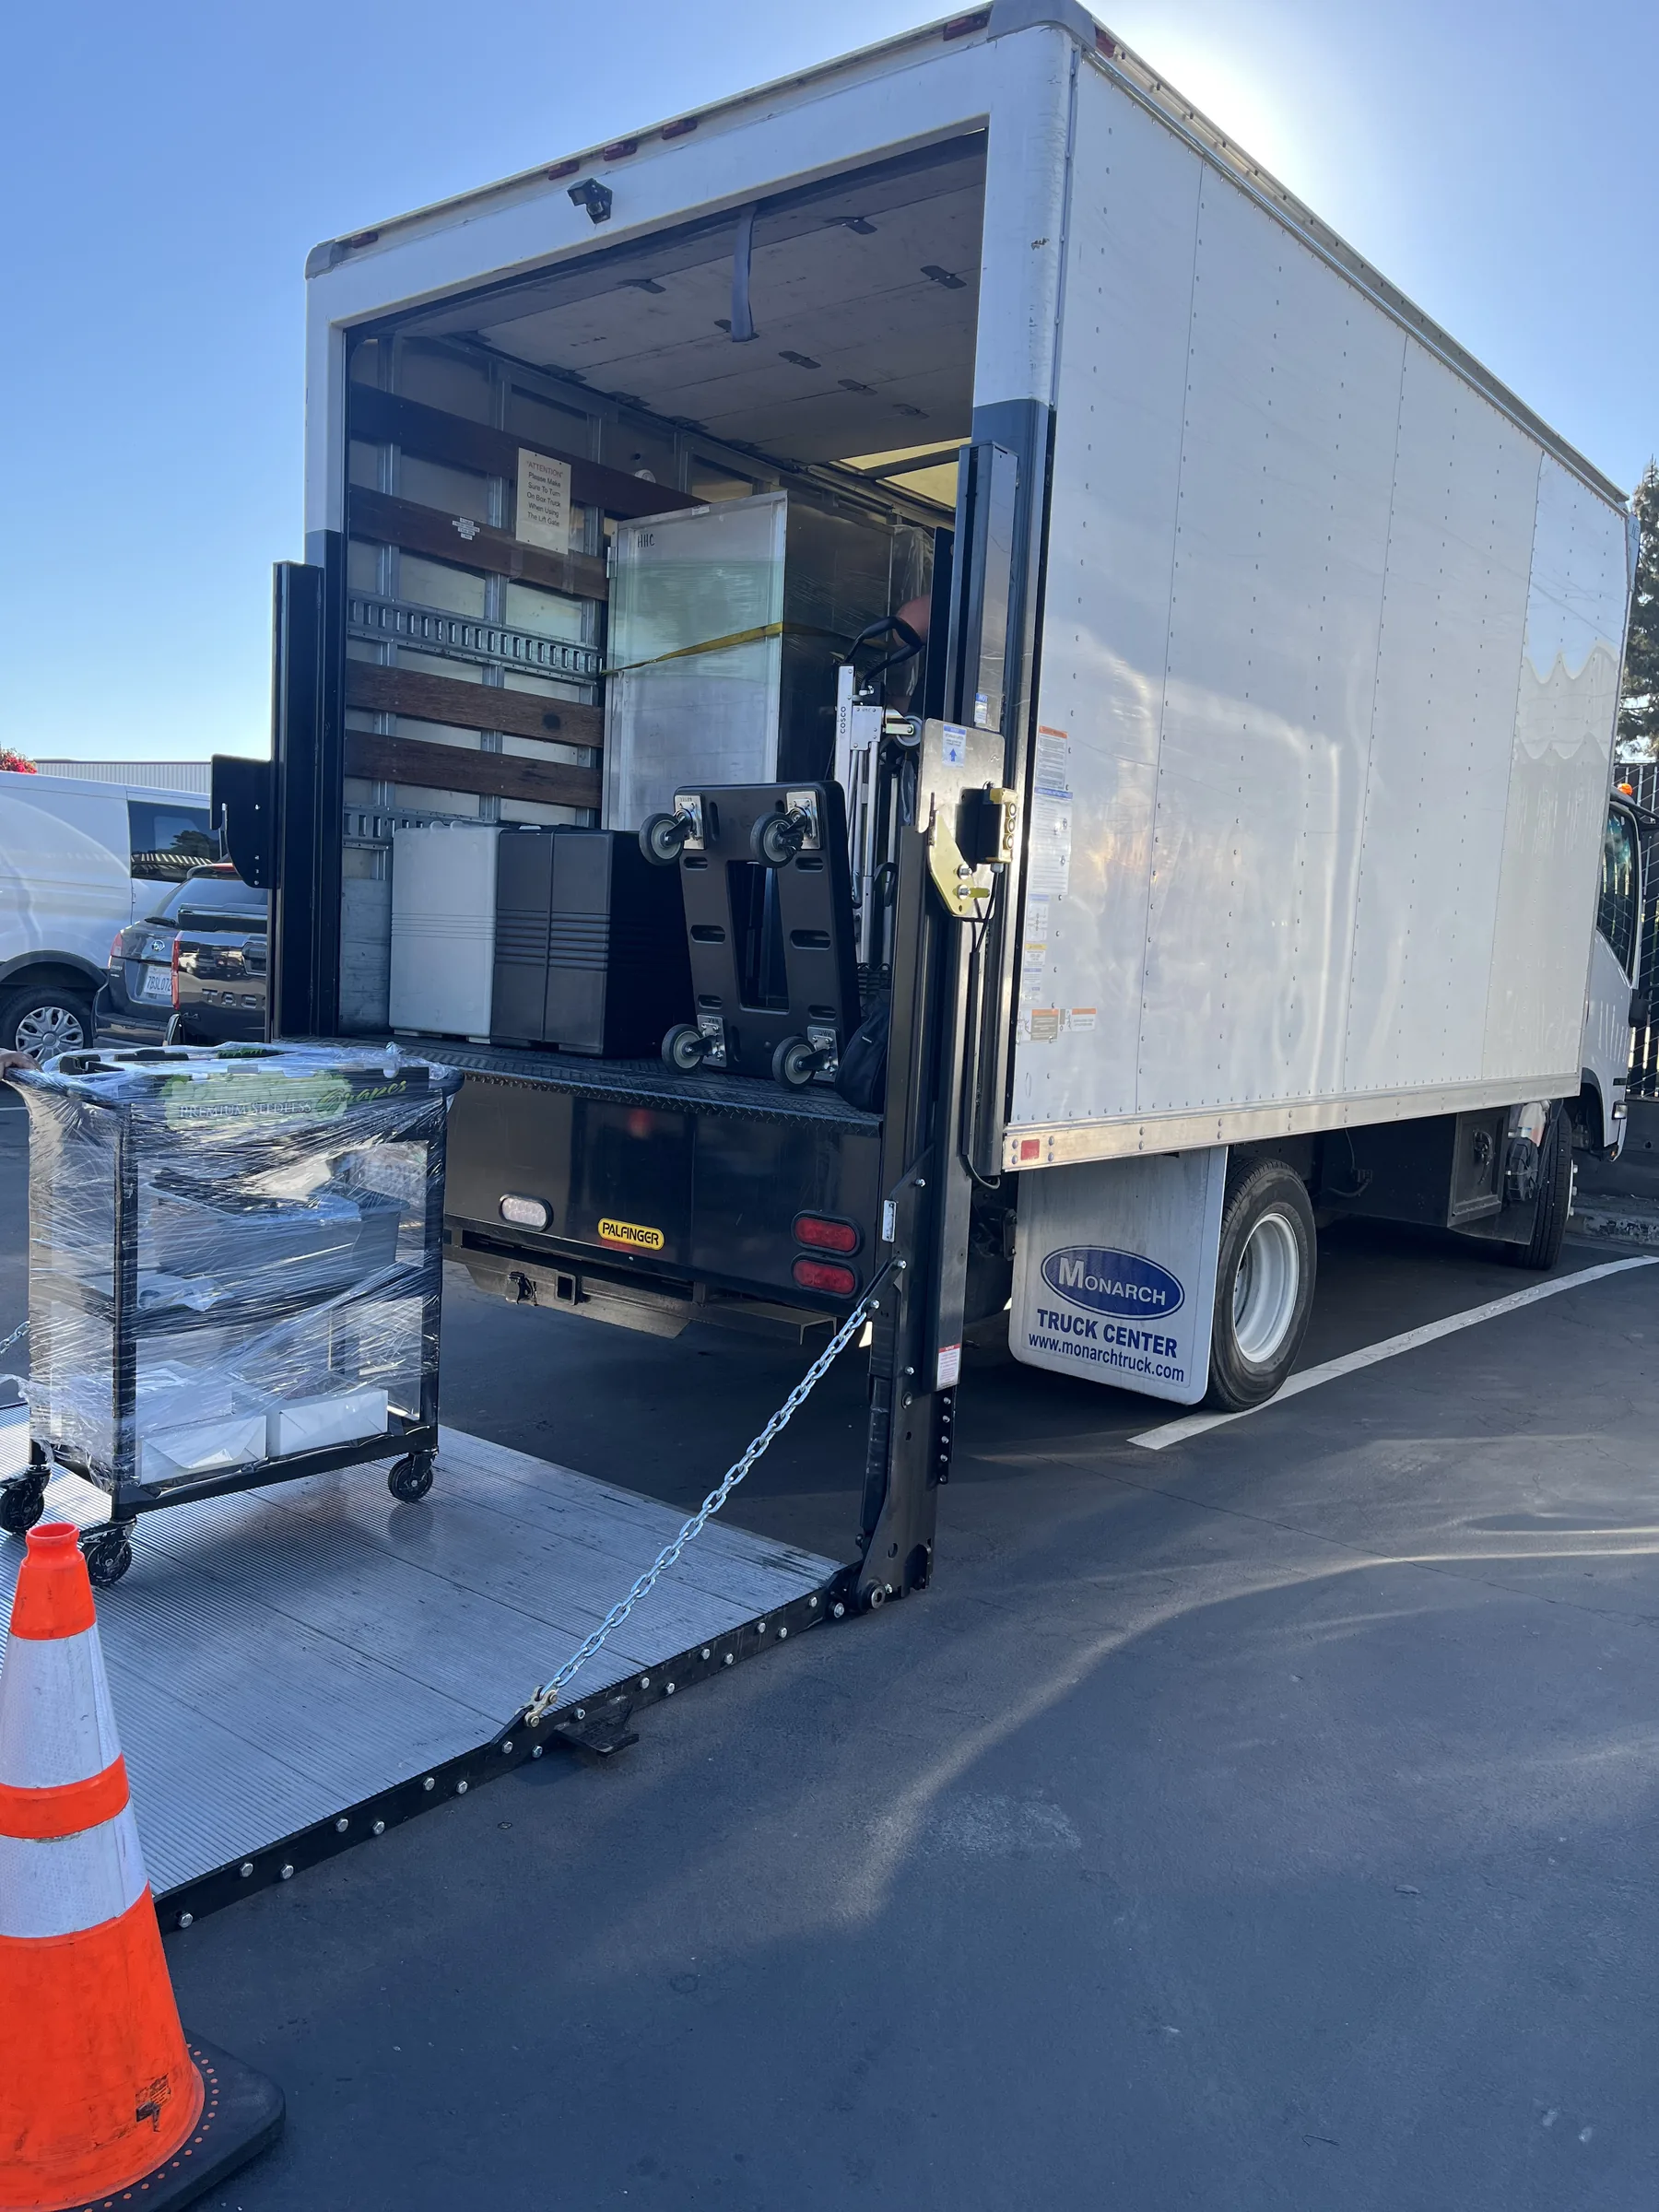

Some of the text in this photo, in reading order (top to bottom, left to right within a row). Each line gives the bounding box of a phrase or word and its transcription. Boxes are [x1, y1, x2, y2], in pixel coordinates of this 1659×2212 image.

[528, 471, 561, 488] Please Make
[528, 481, 561, 498] Sure To Turn
[526, 491, 561, 508] On Box Truck
[528, 501, 559, 518] When Using
[527, 511, 560, 527] The Lift Gate
[637, 533, 656, 548] HHC
[201, 987, 265, 1010] TAC
[316, 1079, 408, 1114] Grapes
[179, 1101, 312, 1119] PREMIUM SEEDLESS
[602, 1221, 659, 1246] PALFINGER
[1057, 1256, 1167, 1306] MONARCH
[1037, 1308, 1178, 1359] TRUCK CENTER
[1029, 1331, 1184, 1382] www.monarchtruck.com
